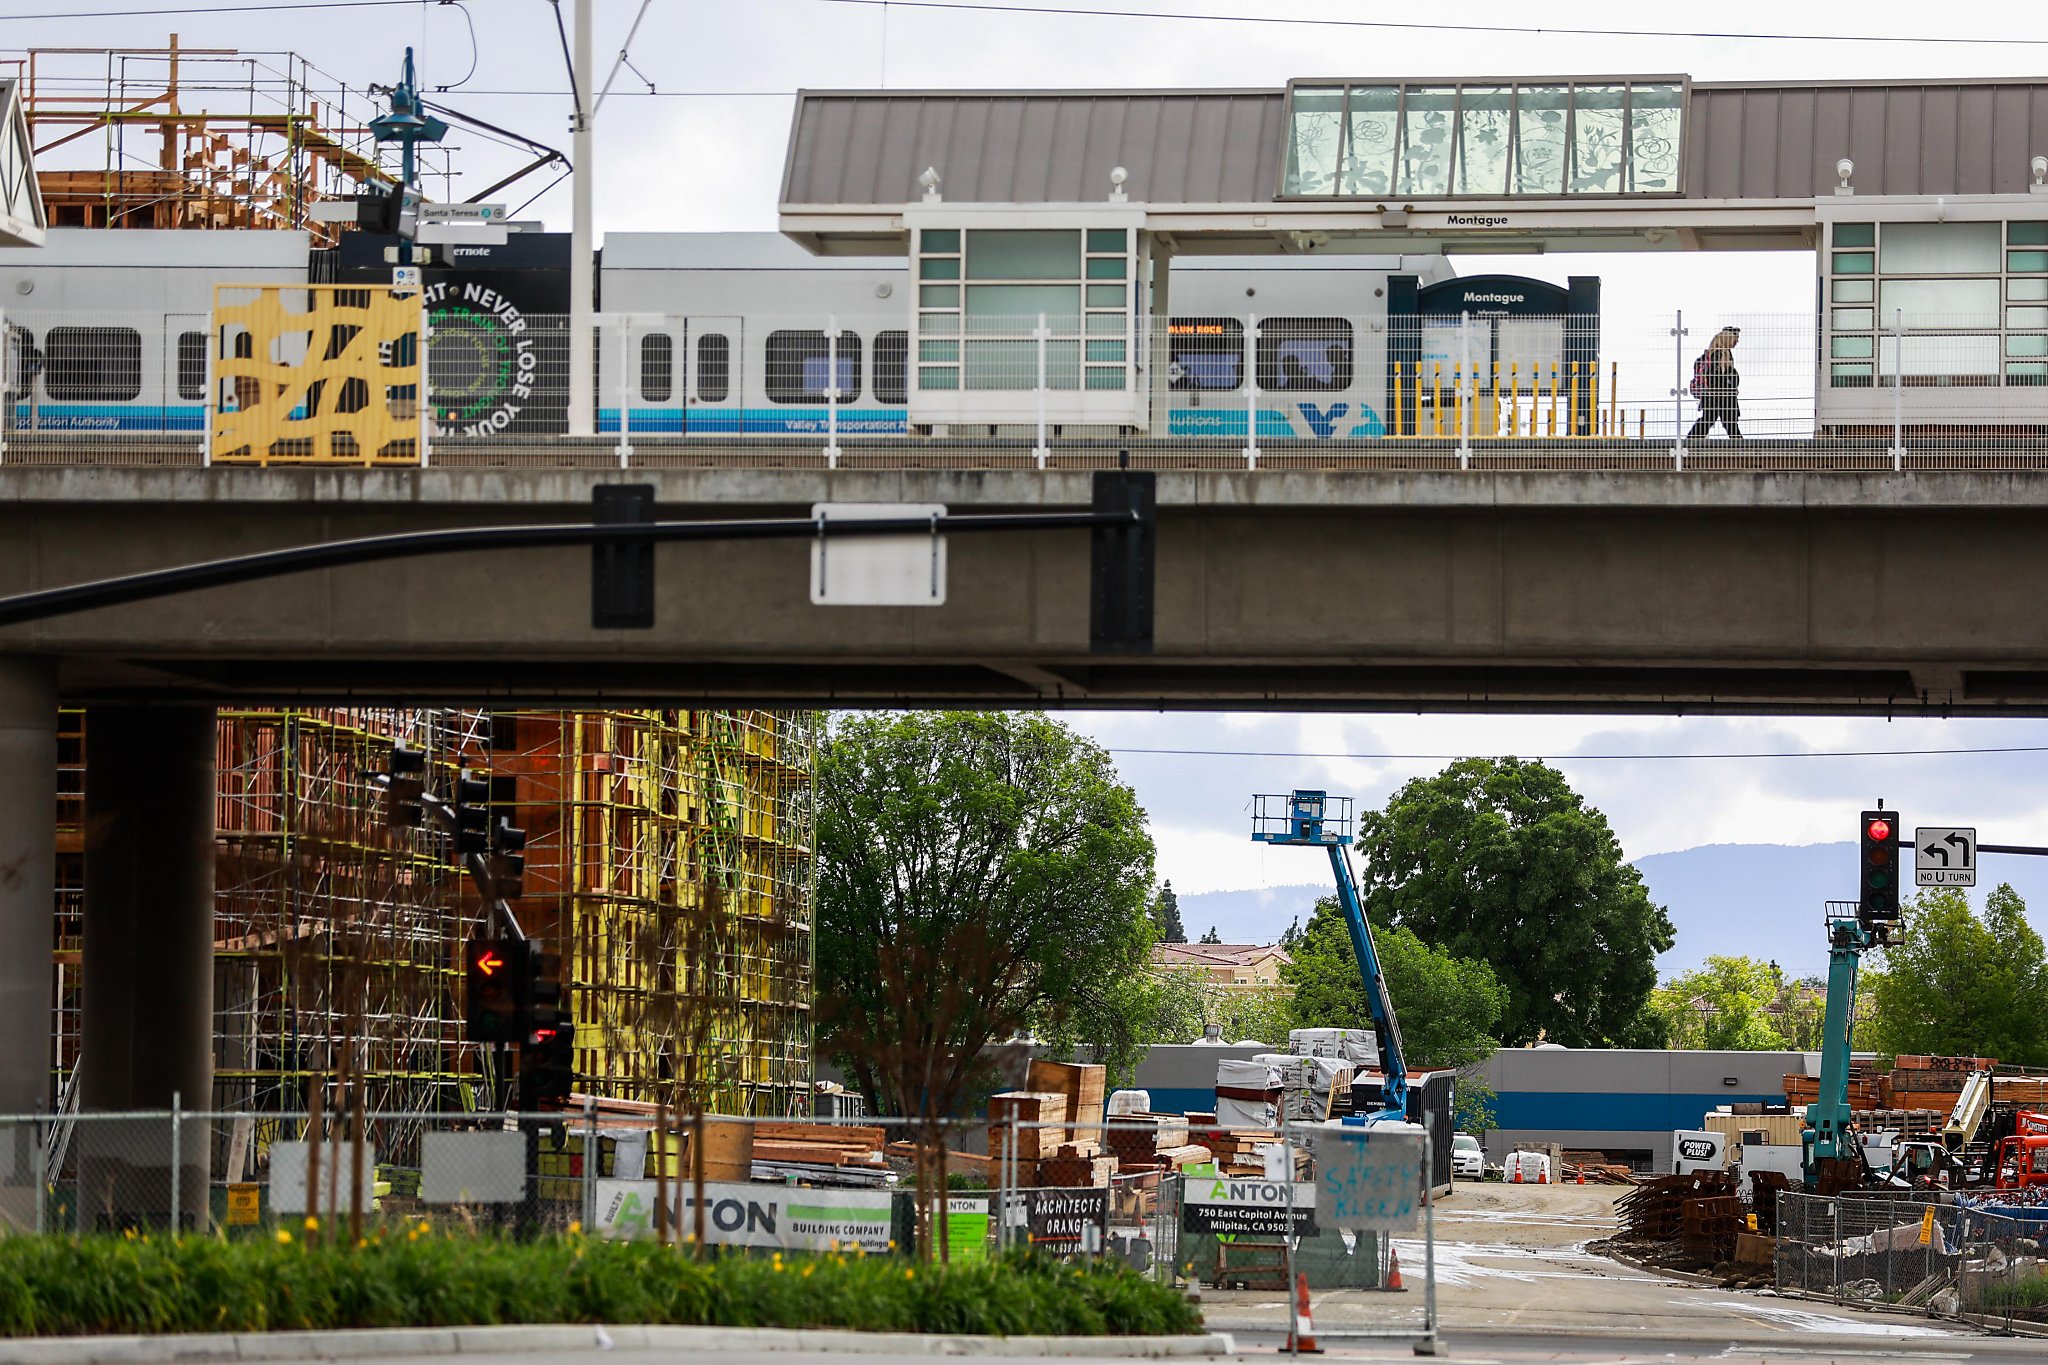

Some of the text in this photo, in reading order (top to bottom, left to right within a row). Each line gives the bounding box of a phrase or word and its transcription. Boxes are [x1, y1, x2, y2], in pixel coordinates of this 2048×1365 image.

[424, 209, 479, 217] Santa Teresa
[1447, 215, 1508, 227] Montague
[453, 248, 491, 256] ernote
[1463, 292, 1524, 304] Montague
[1196, 325, 1223, 334] ROCK
[463, 282, 526, 336] NEVER
[512, 339, 537, 399] LOSE
[70, 417, 120, 429] Authority
[785, 420, 817, 431] Valley
[819, 420, 897, 431] Trnsportation
[1169, 413, 1222, 426] lutions
[1920, 871, 1971, 883] NO U TURN
[1683, 1141, 1712, 1151] POWER
[1685, 1148, 1708, 1157] PLUS!
[1209, 1180, 1294, 1202] ANTON
[604, 1200, 620, 1224] BUILT
[950, 1201, 976, 1211] NTON
[1035, 1198, 1102, 1214] ARCHITECTS
[1198, 1208, 1216, 1217] 750
[1217, 1209, 1237, 1218] East
[1239, 1209, 1272, 1221] Capitol
[792, 1222, 885, 1236] BUILDING COMPANY
[1210, 1221, 1250, 1232] Milpitas,
[1252, 1222, 1265, 1231] CA
